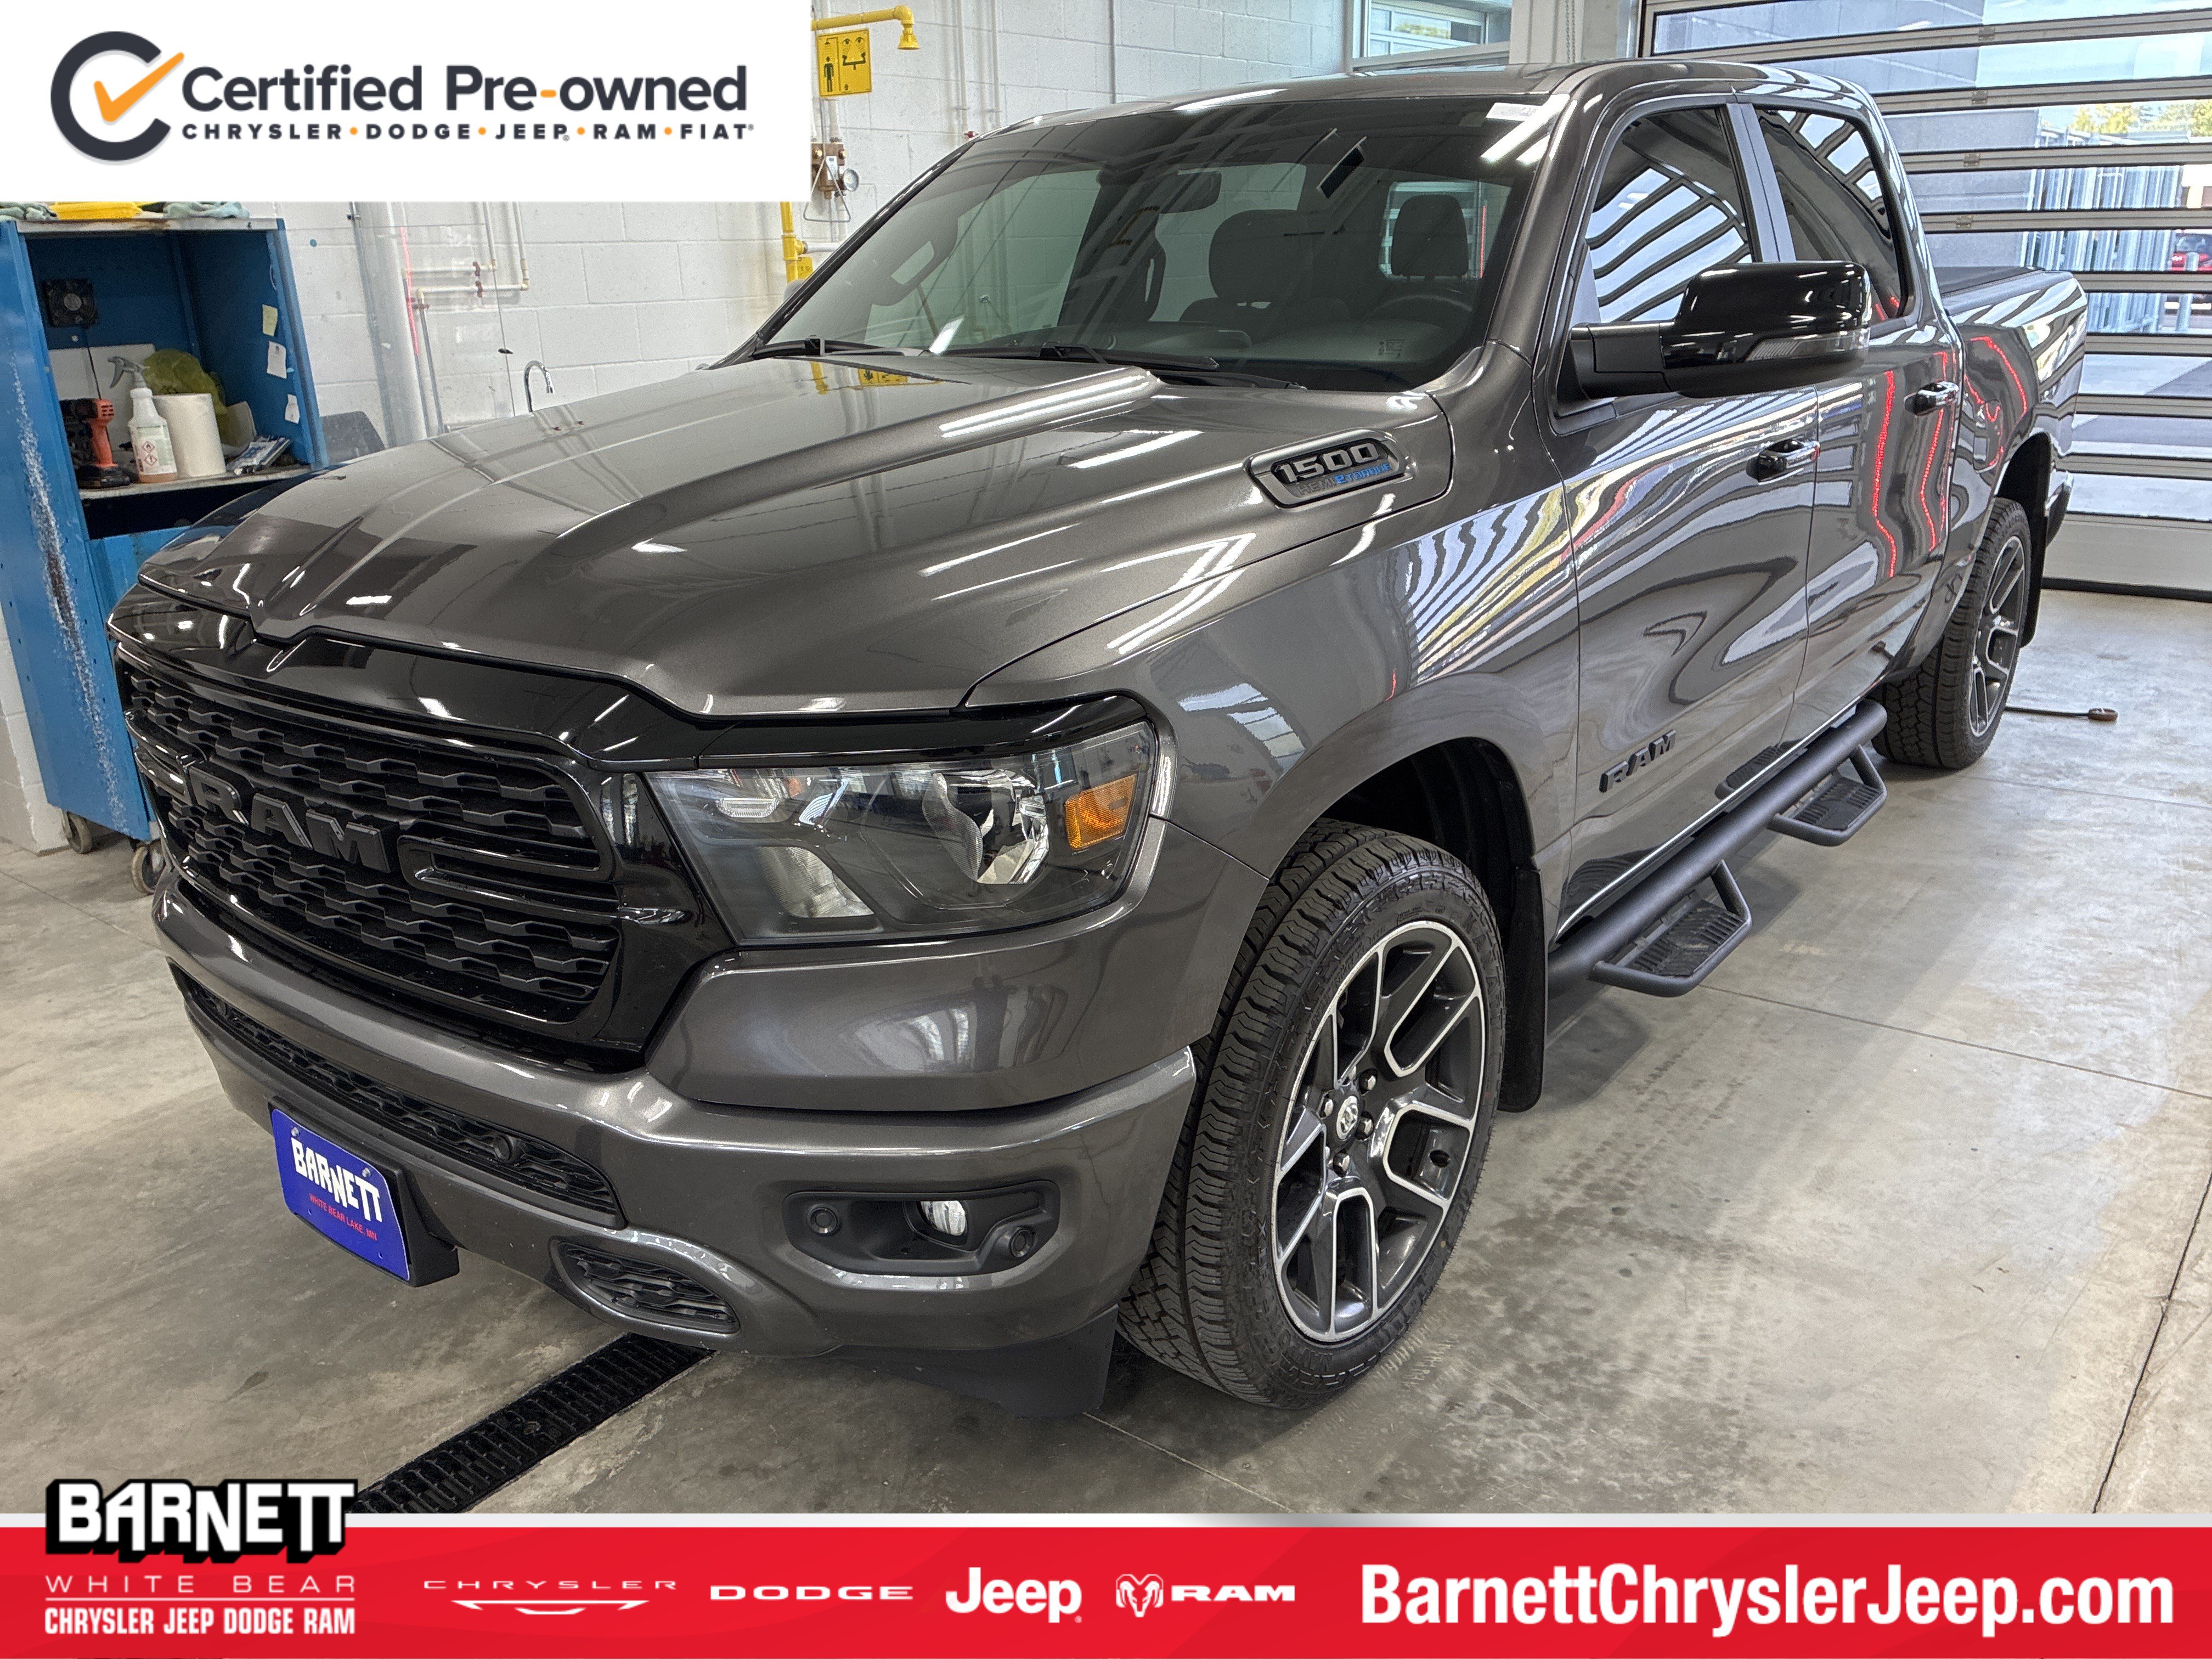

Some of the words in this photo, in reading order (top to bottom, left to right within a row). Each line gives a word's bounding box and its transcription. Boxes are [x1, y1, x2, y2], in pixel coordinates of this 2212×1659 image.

[1274, 442, 1379, 483] 1500
[1296, 476, 1337, 496] HEMI
[1599, 729, 1677, 793] RAM
[188, 764, 391, 873] RAM
[291, 1137, 383, 1223] BARNETT
[309, 1193, 328, 1212] WHITE
[328, 1205, 346, 1223] BEAR
[346, 1215, 365, 1237] LAKE,
[365, 1228, 377, 1242] MN
